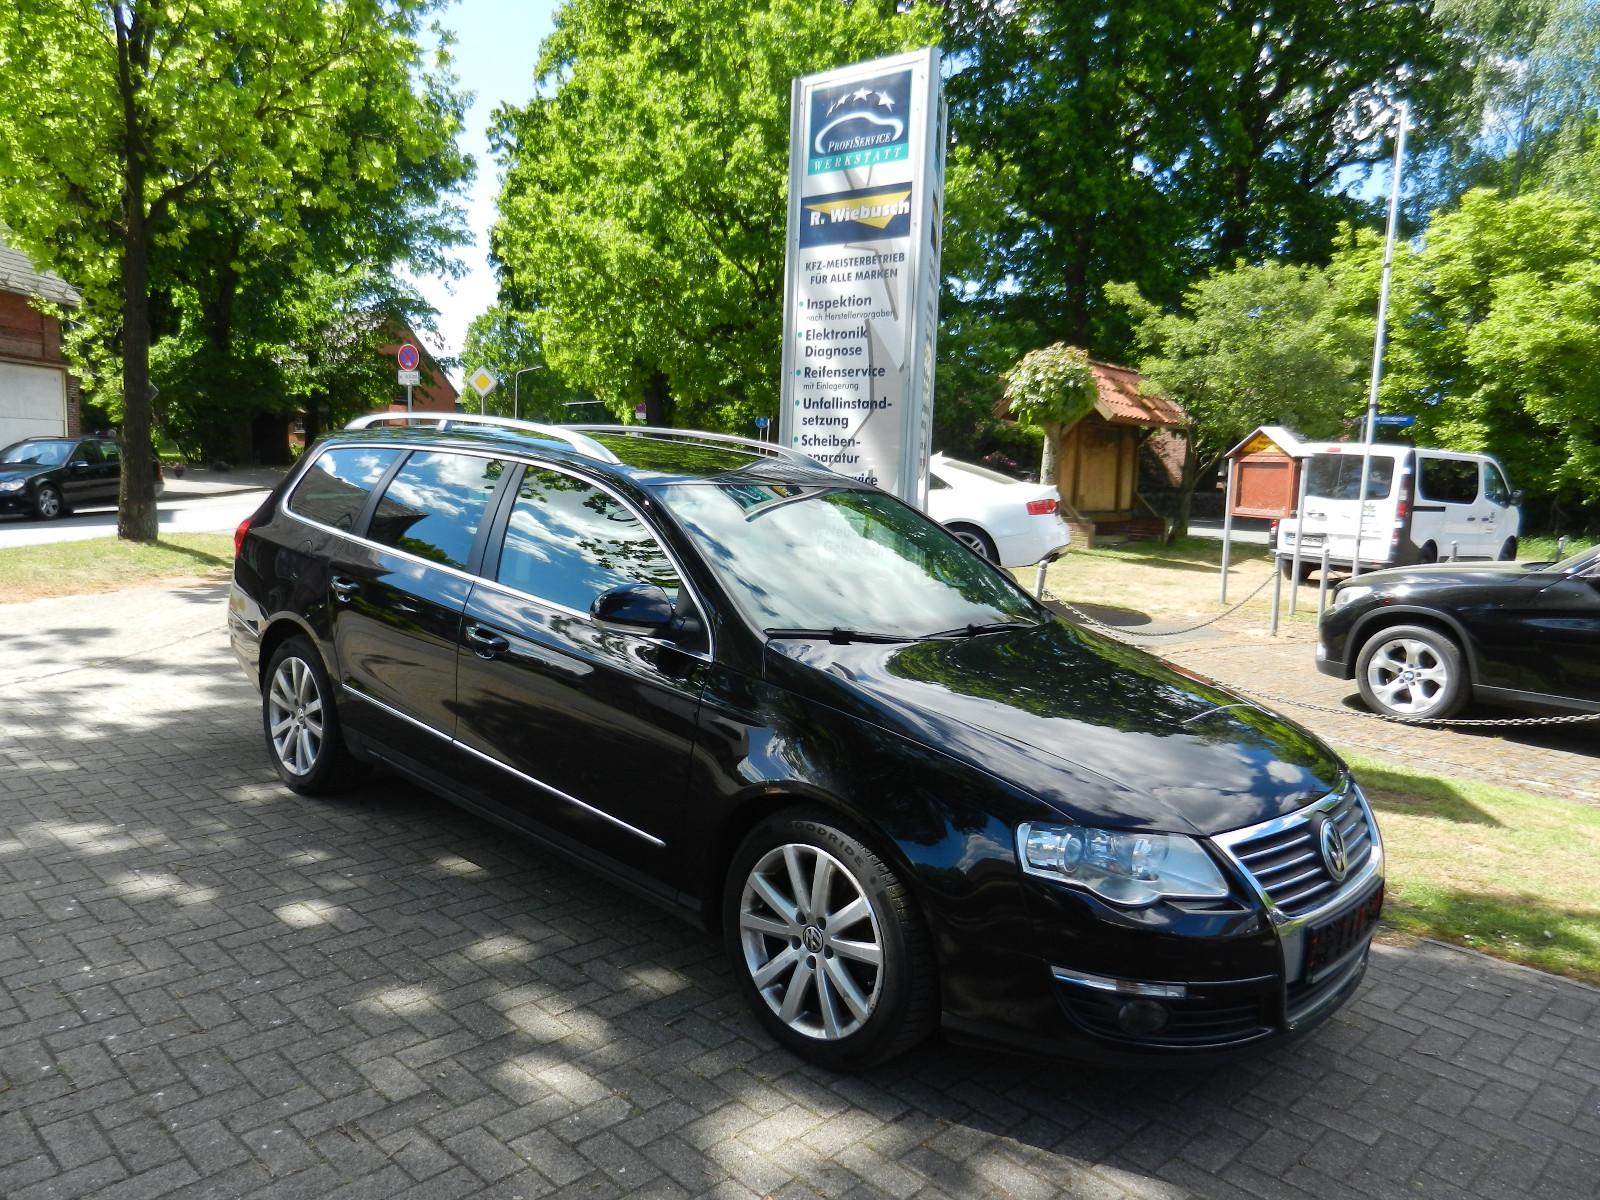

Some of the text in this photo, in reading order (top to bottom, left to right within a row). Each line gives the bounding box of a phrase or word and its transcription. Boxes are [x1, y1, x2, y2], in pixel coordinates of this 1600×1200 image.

[814, 146, 902, 170] WERKSTATT
[810, 199, 910, 226] R. Wiebusch
[805, 252, 905, 272] KFZ-MEISTERBETRIEB
[810, 268, 898, 286] FÜR ALLE MARKEN
[806, 294, 872, 312] Inspektion
[805, 326, 868, 342] Elektronik
[804, 345, 863, 360] Diagnose
[804, 365, 886, 379] Reifenservice
[803, 381, 859, 392] mit Einlagerung
[803, 396, 893, 410] Unfallinstand-
[801, 414, 849, 429] setzung
[801, 434, 861, 447] Scheiben-
[808, 452, 860, 464] paratur
